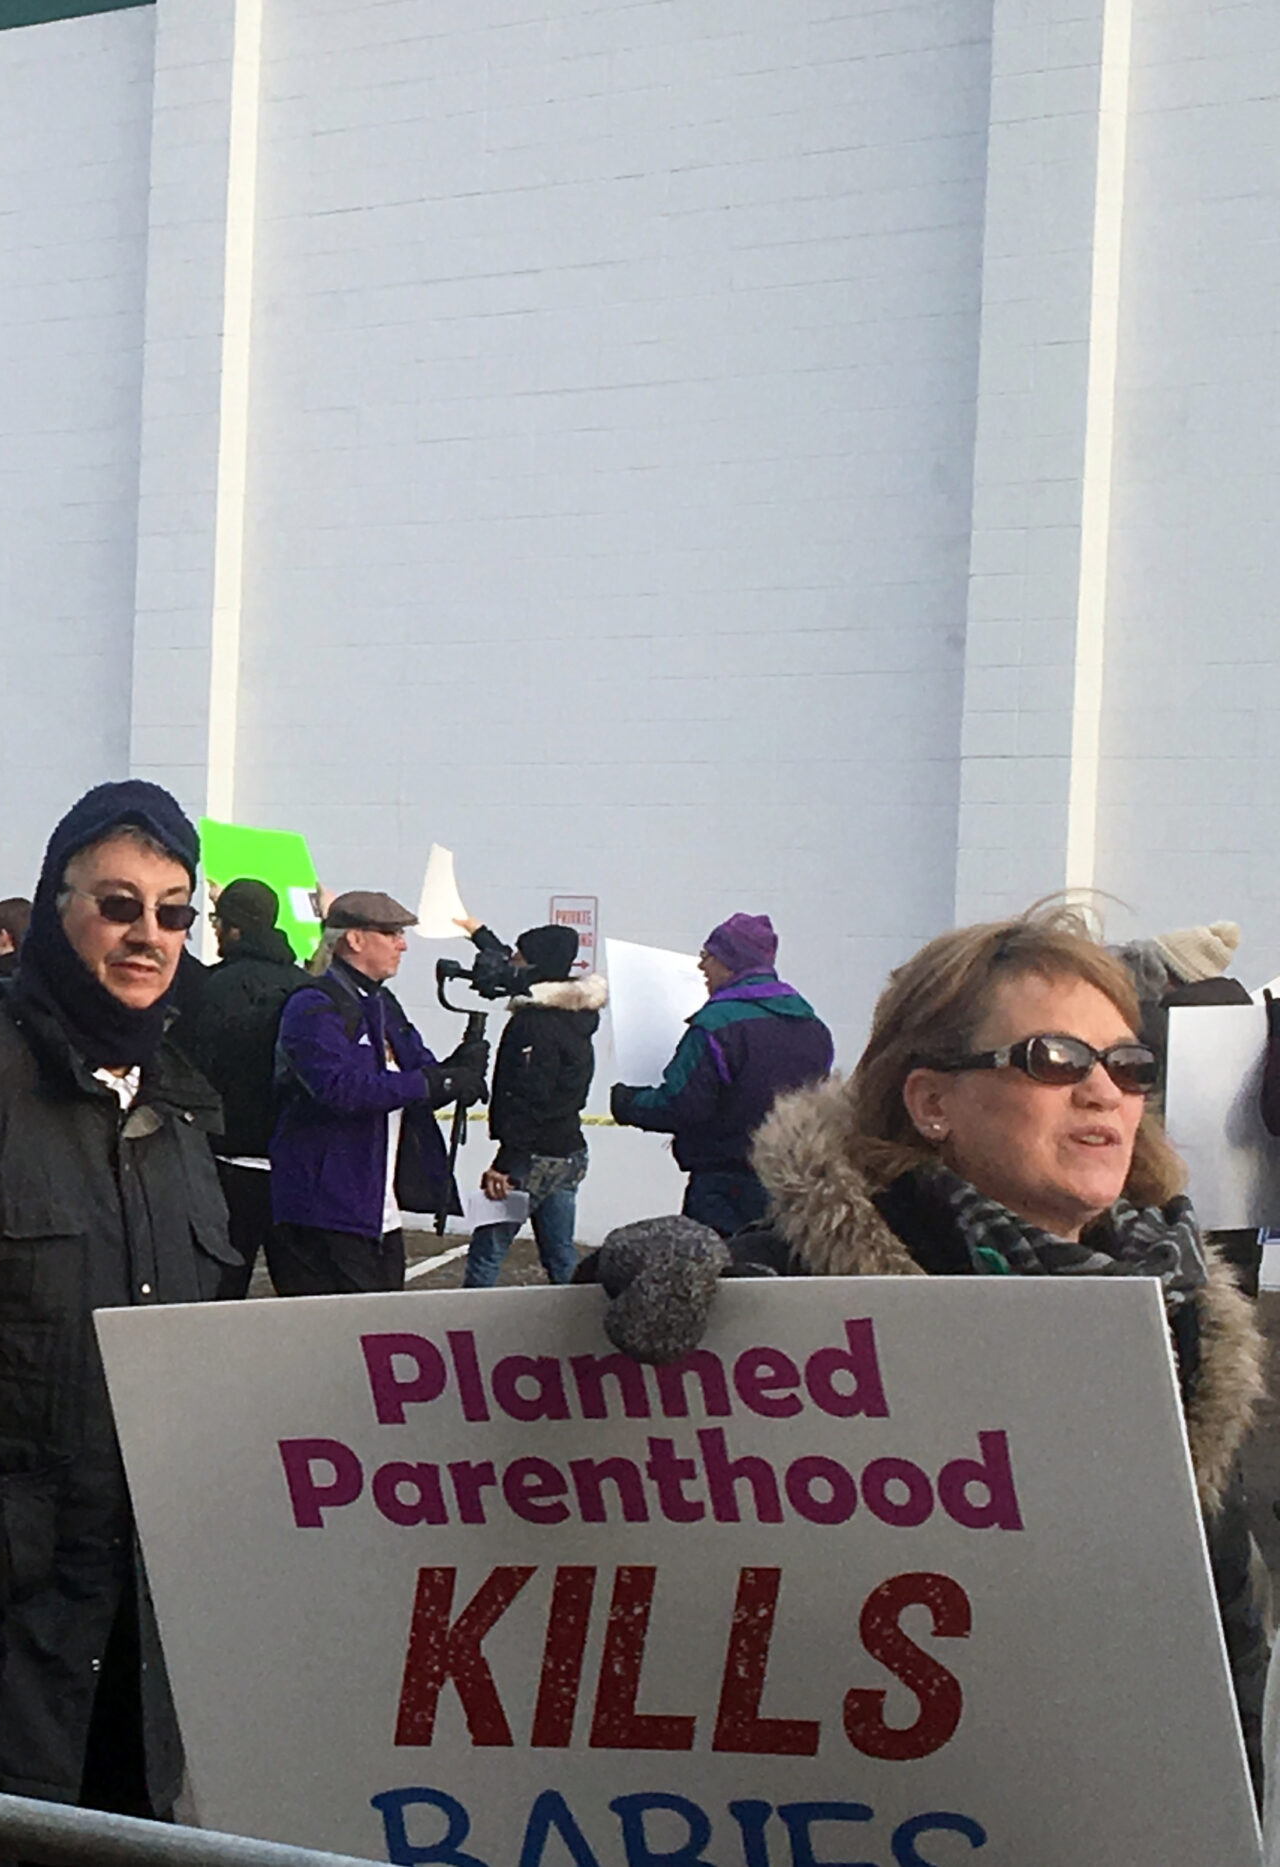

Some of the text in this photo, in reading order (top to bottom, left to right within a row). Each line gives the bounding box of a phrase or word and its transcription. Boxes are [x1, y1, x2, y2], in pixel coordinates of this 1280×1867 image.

[360, 1317, 889, 1425] Planned
[277, 1427, 1024, 1532] Parenthood
[393, 1565, 973, 1761] KILLS
